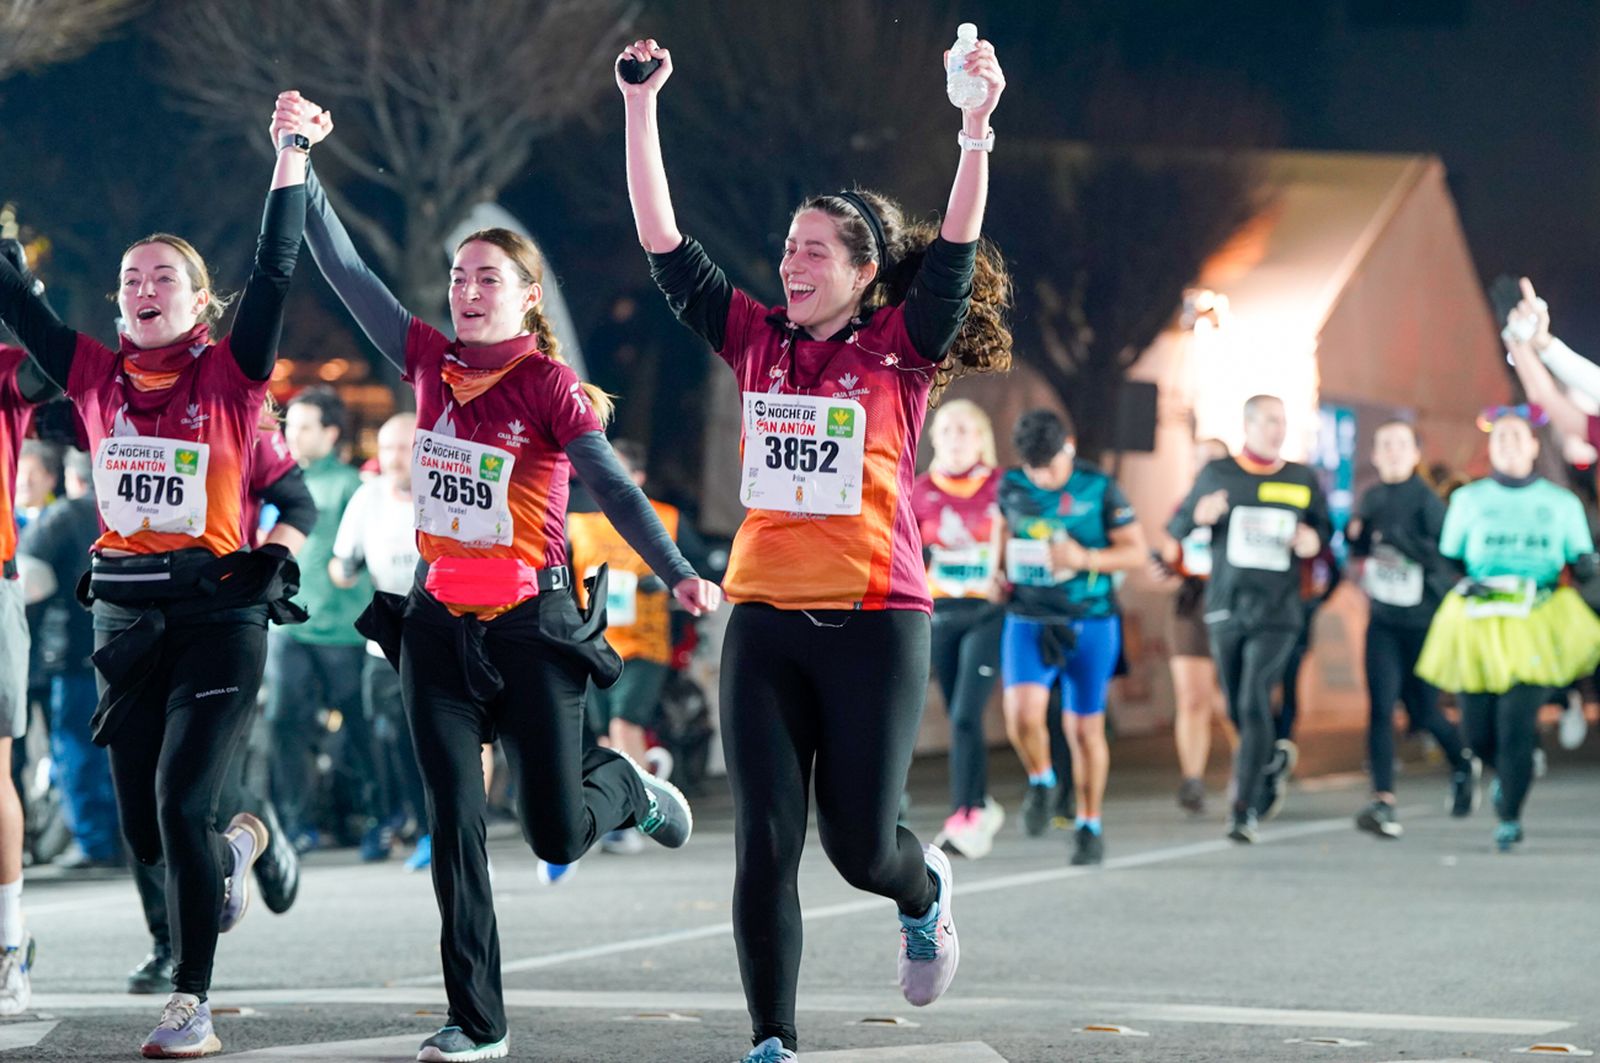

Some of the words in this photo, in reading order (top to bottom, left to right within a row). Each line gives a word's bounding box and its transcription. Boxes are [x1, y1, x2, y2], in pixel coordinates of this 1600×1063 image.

[768, 407, 800, 419] NOCHE
[802, 409, 816, 421] DE
[756, 418, 777, 434] SAN
[780, 420, 816, 436] ANTÓN
[119, 447, 151, 458] NOCHE
[153, 450, 165, 459] DE
[431, 446, 459, 459] NOCHE
[461, 451, 472, 463] DE
[765, 436, 839, 473] 3852
[105, 459, 127, 470] SAN
[130, 459, 166, 472] ANTÓN
[421, 455, 439, 469] SAN
[440, 461, 472, 475] ANTÓN
[117, 473, 184, 506] 4676
[428, 471, 492, 510] 2659
[448, 505, 467, 515] Isabel
[195, 687, 225, 698] GUARDIA
